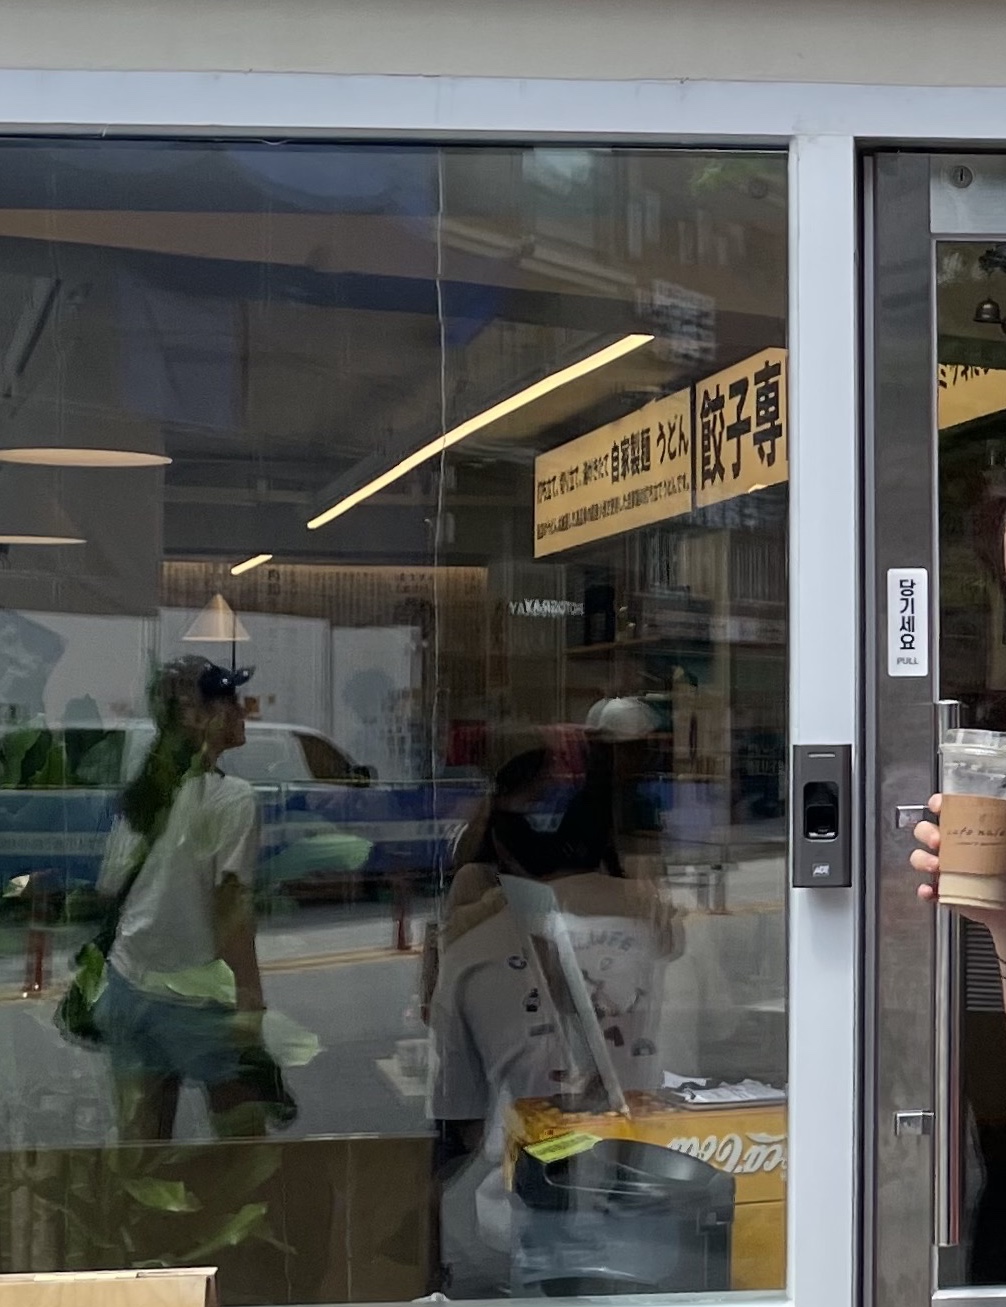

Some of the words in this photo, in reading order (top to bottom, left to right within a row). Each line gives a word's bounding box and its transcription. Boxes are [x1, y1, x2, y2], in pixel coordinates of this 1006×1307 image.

[656, 414, 690, 465] うどん
[899, 579, 916, 650] 당기세요
[896, 657, 919, 665] PULL
